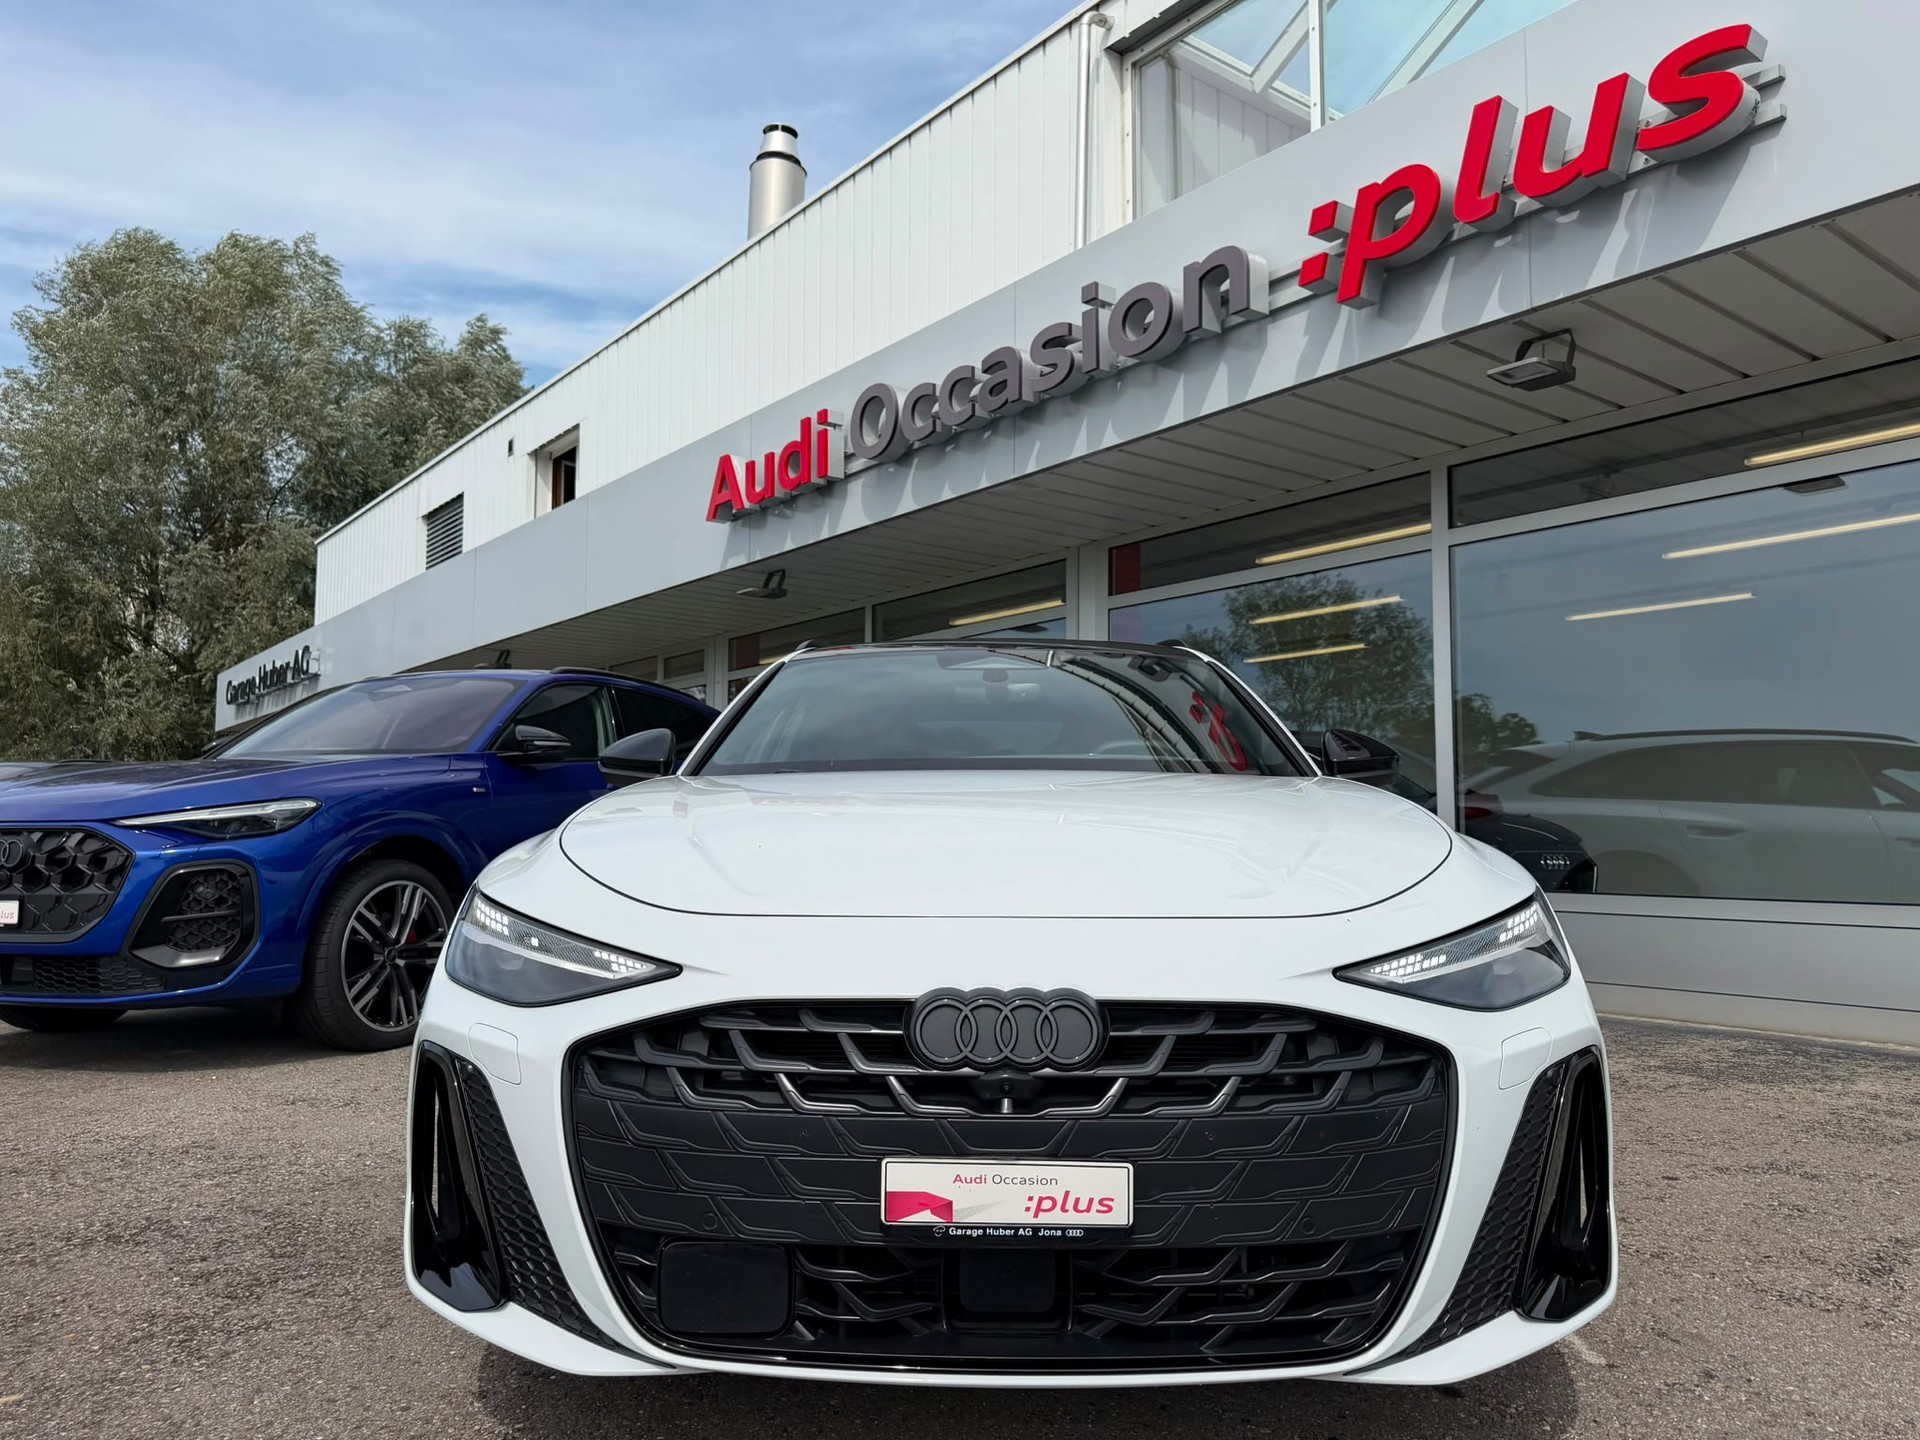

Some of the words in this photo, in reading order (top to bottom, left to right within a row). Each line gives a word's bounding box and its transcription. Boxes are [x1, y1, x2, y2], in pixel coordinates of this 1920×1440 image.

[706, 408, 829, 522] Audi
[851, 245, 1251, 458] Occasion
[1299, 24, 1747, 303] :plus
[226, 675, 256, 705] Garage
[258, 659, 290, 692] Huber
[292, 645, 311, 680] AG
[953, 1174, 987, 1184] Audi
[992, 1174, 1059, 1186] Occasion
[1025, 1190, 1115, 1218] :plus
[949, 1227, 984, 1236] Garage
[986, 1227, 1015, 1236] Huber
[1018, 1227, 1033, 1236] AG
[1038, 1228, 1062, 1237] Jona
